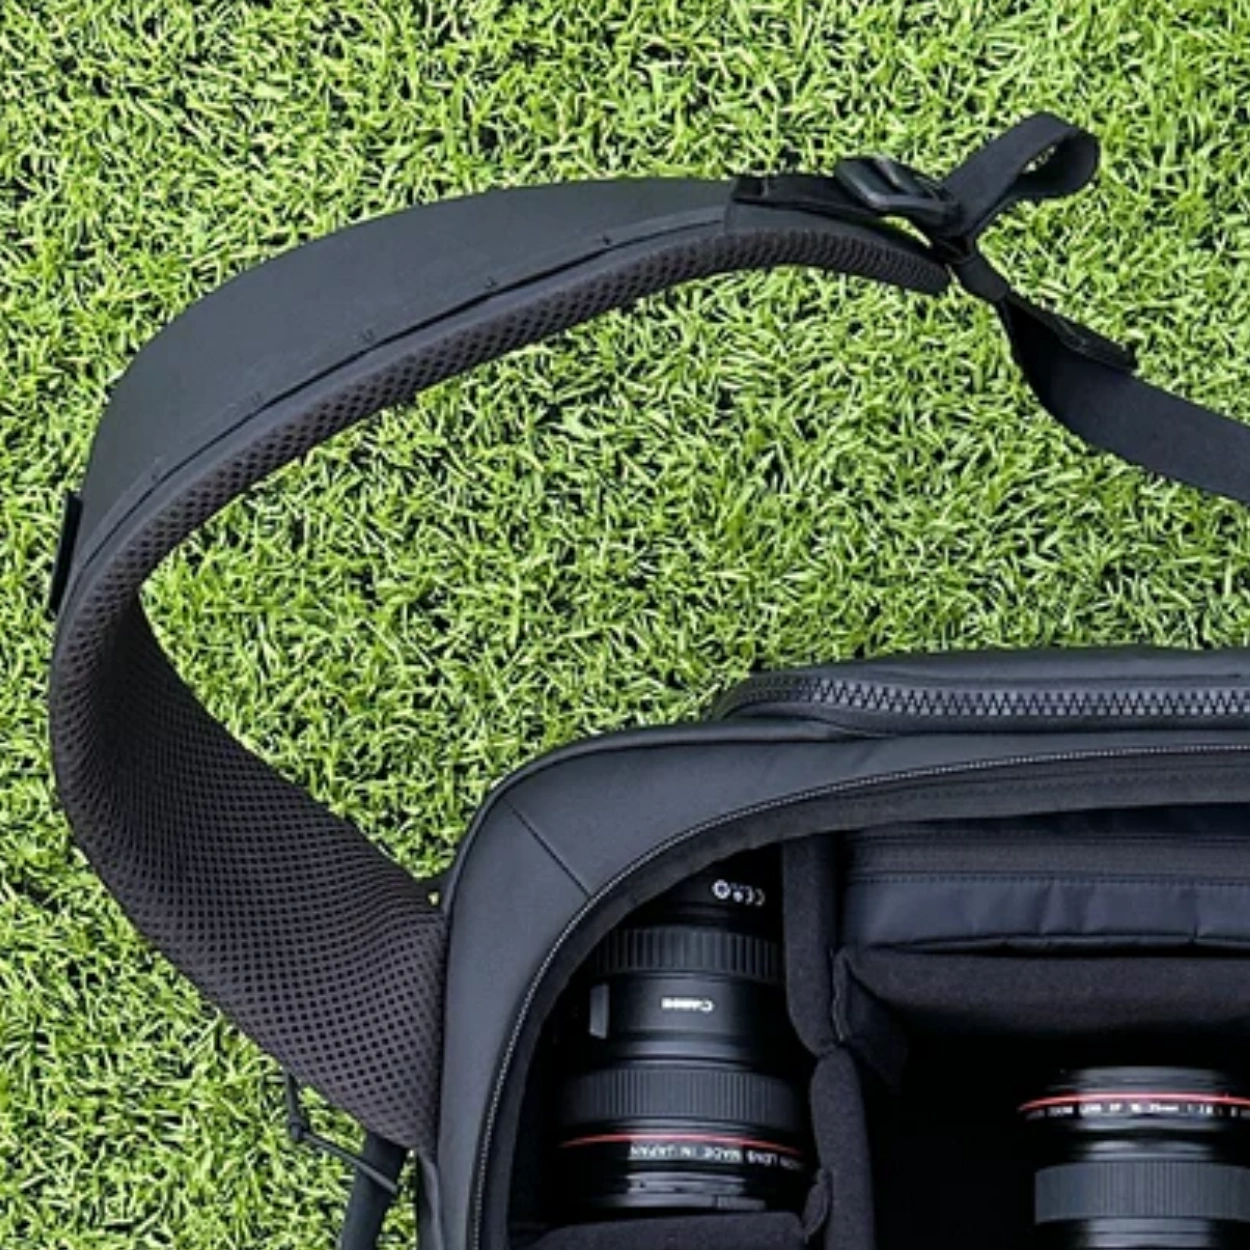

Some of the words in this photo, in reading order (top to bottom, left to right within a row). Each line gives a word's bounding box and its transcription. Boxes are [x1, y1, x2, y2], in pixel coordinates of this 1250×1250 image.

[629, 1144, 674, 1160] JAPAN
[678, 1145, 698, 1160] IN
[702, 1146, 743, 1163] MADE
